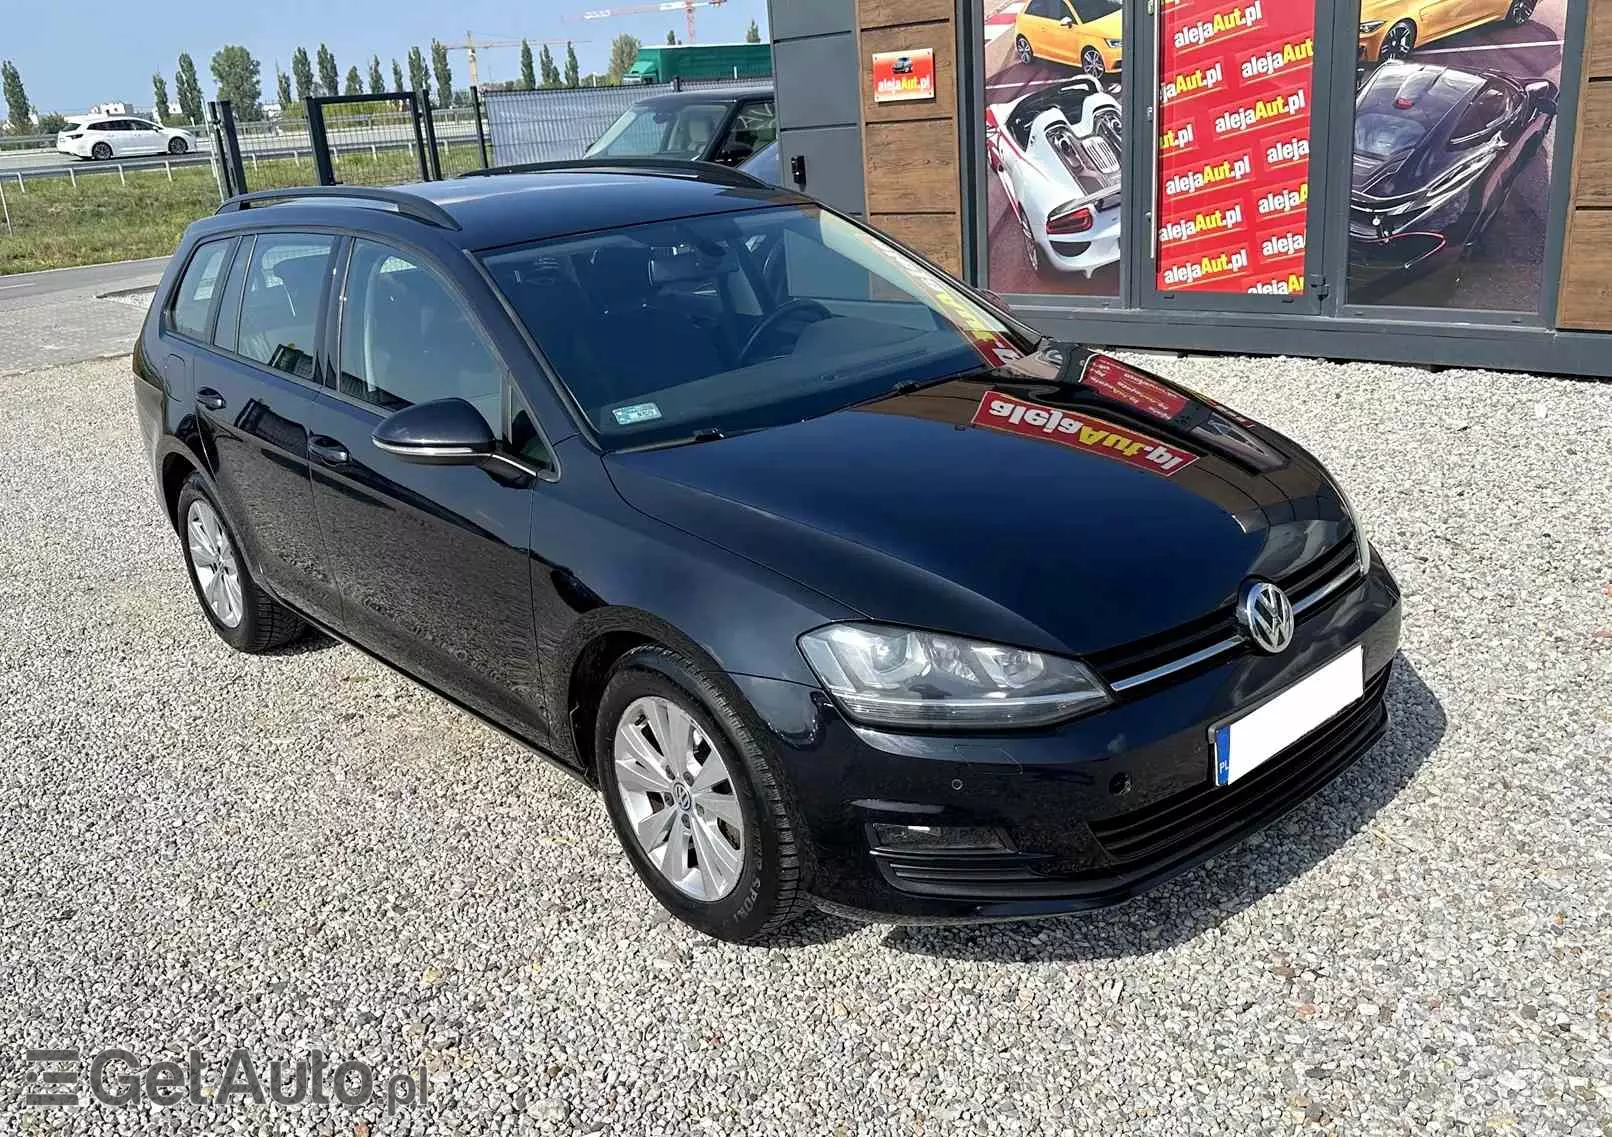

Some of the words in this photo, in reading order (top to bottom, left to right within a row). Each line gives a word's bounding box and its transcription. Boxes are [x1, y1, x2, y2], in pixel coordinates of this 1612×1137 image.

[1173, 0, 1263, 48] alejaAut.pl
[1160, 63, 1223, 103] jaAut.pl
[1215, 89, 1306, 133] alejaAut.pl
[1165, 155, 1251, 195] alejaAut.pl
[1159, 204, 1242, 241] alejaAut.pl
[1262, 228, 1306, 256] aleja
[1163, 249, 1248, 285] alejaAut.pl
[1219, 760, 1230, 775] PL
